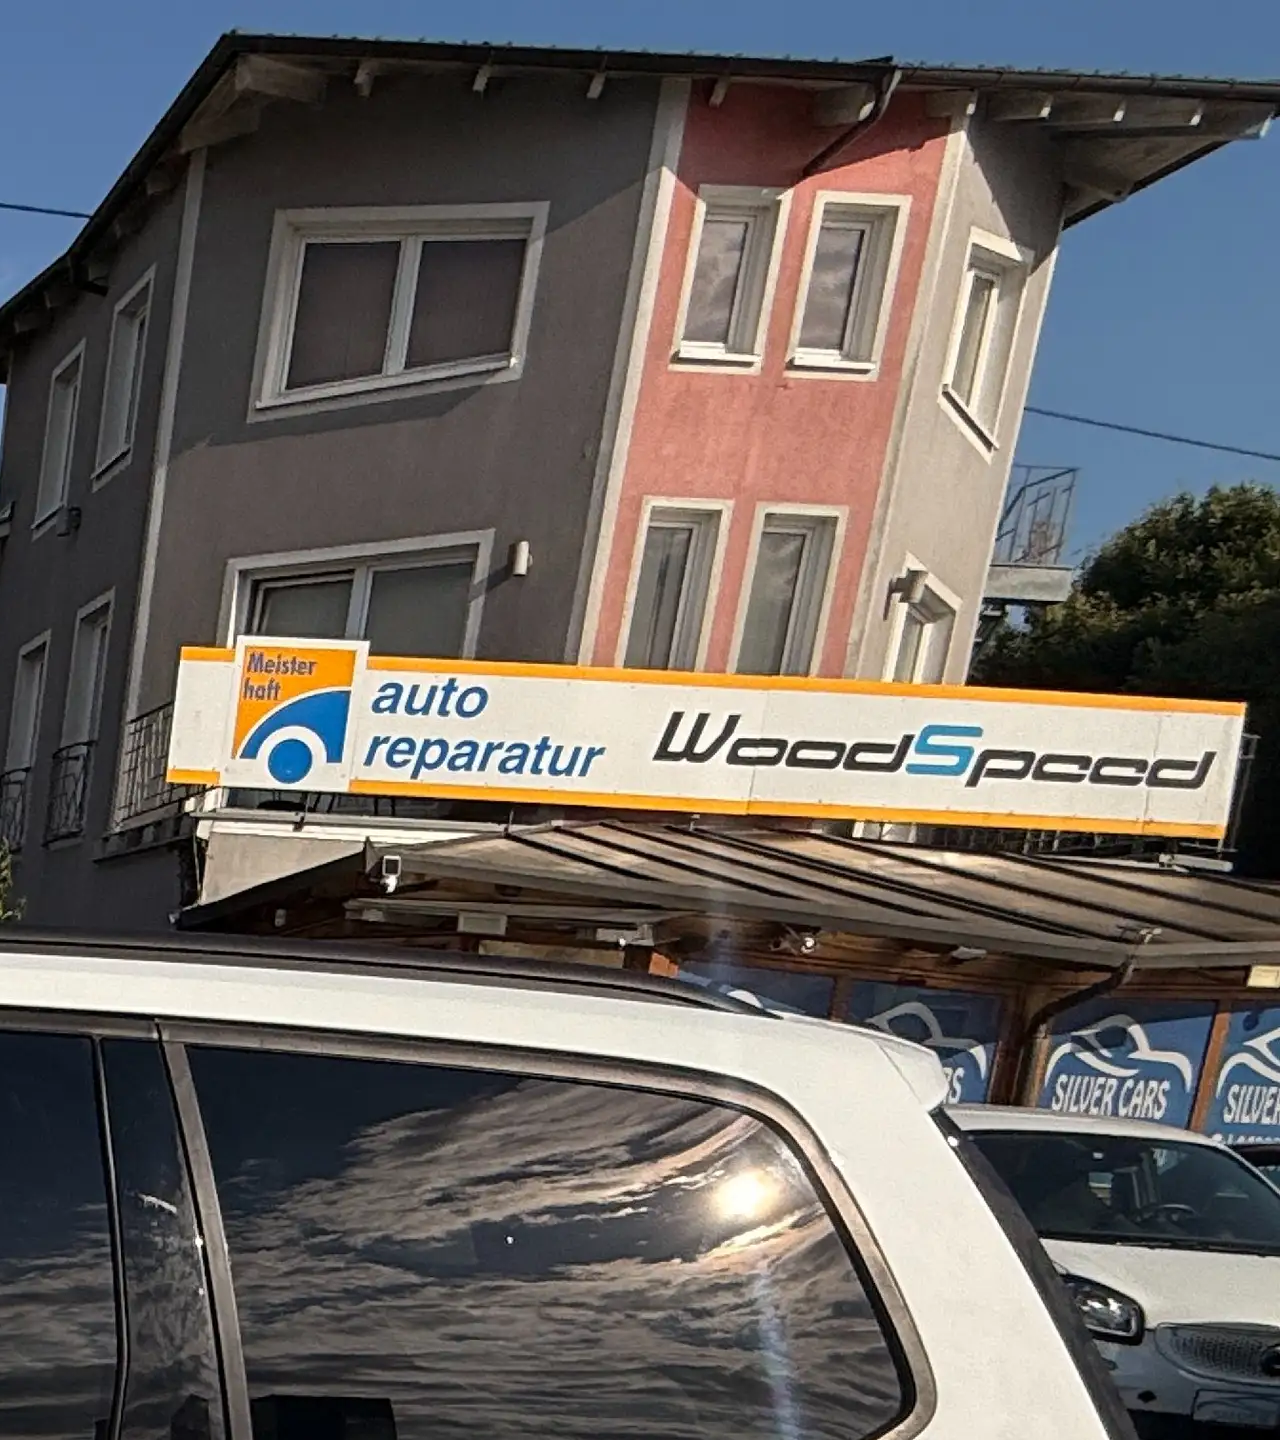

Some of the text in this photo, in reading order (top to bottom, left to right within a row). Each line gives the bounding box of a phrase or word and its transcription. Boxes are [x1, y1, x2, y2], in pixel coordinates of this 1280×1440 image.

[247, 652, 317, 675] Meister
[243, 677, 280, 701] haft
[371, 678, 488, 718] auto
[363, 736, 606, 779] reparatur
[653, 710, 1216, 790] WoodSpeed
[1051, 1074, 1171, 1120] SILVER CARS
